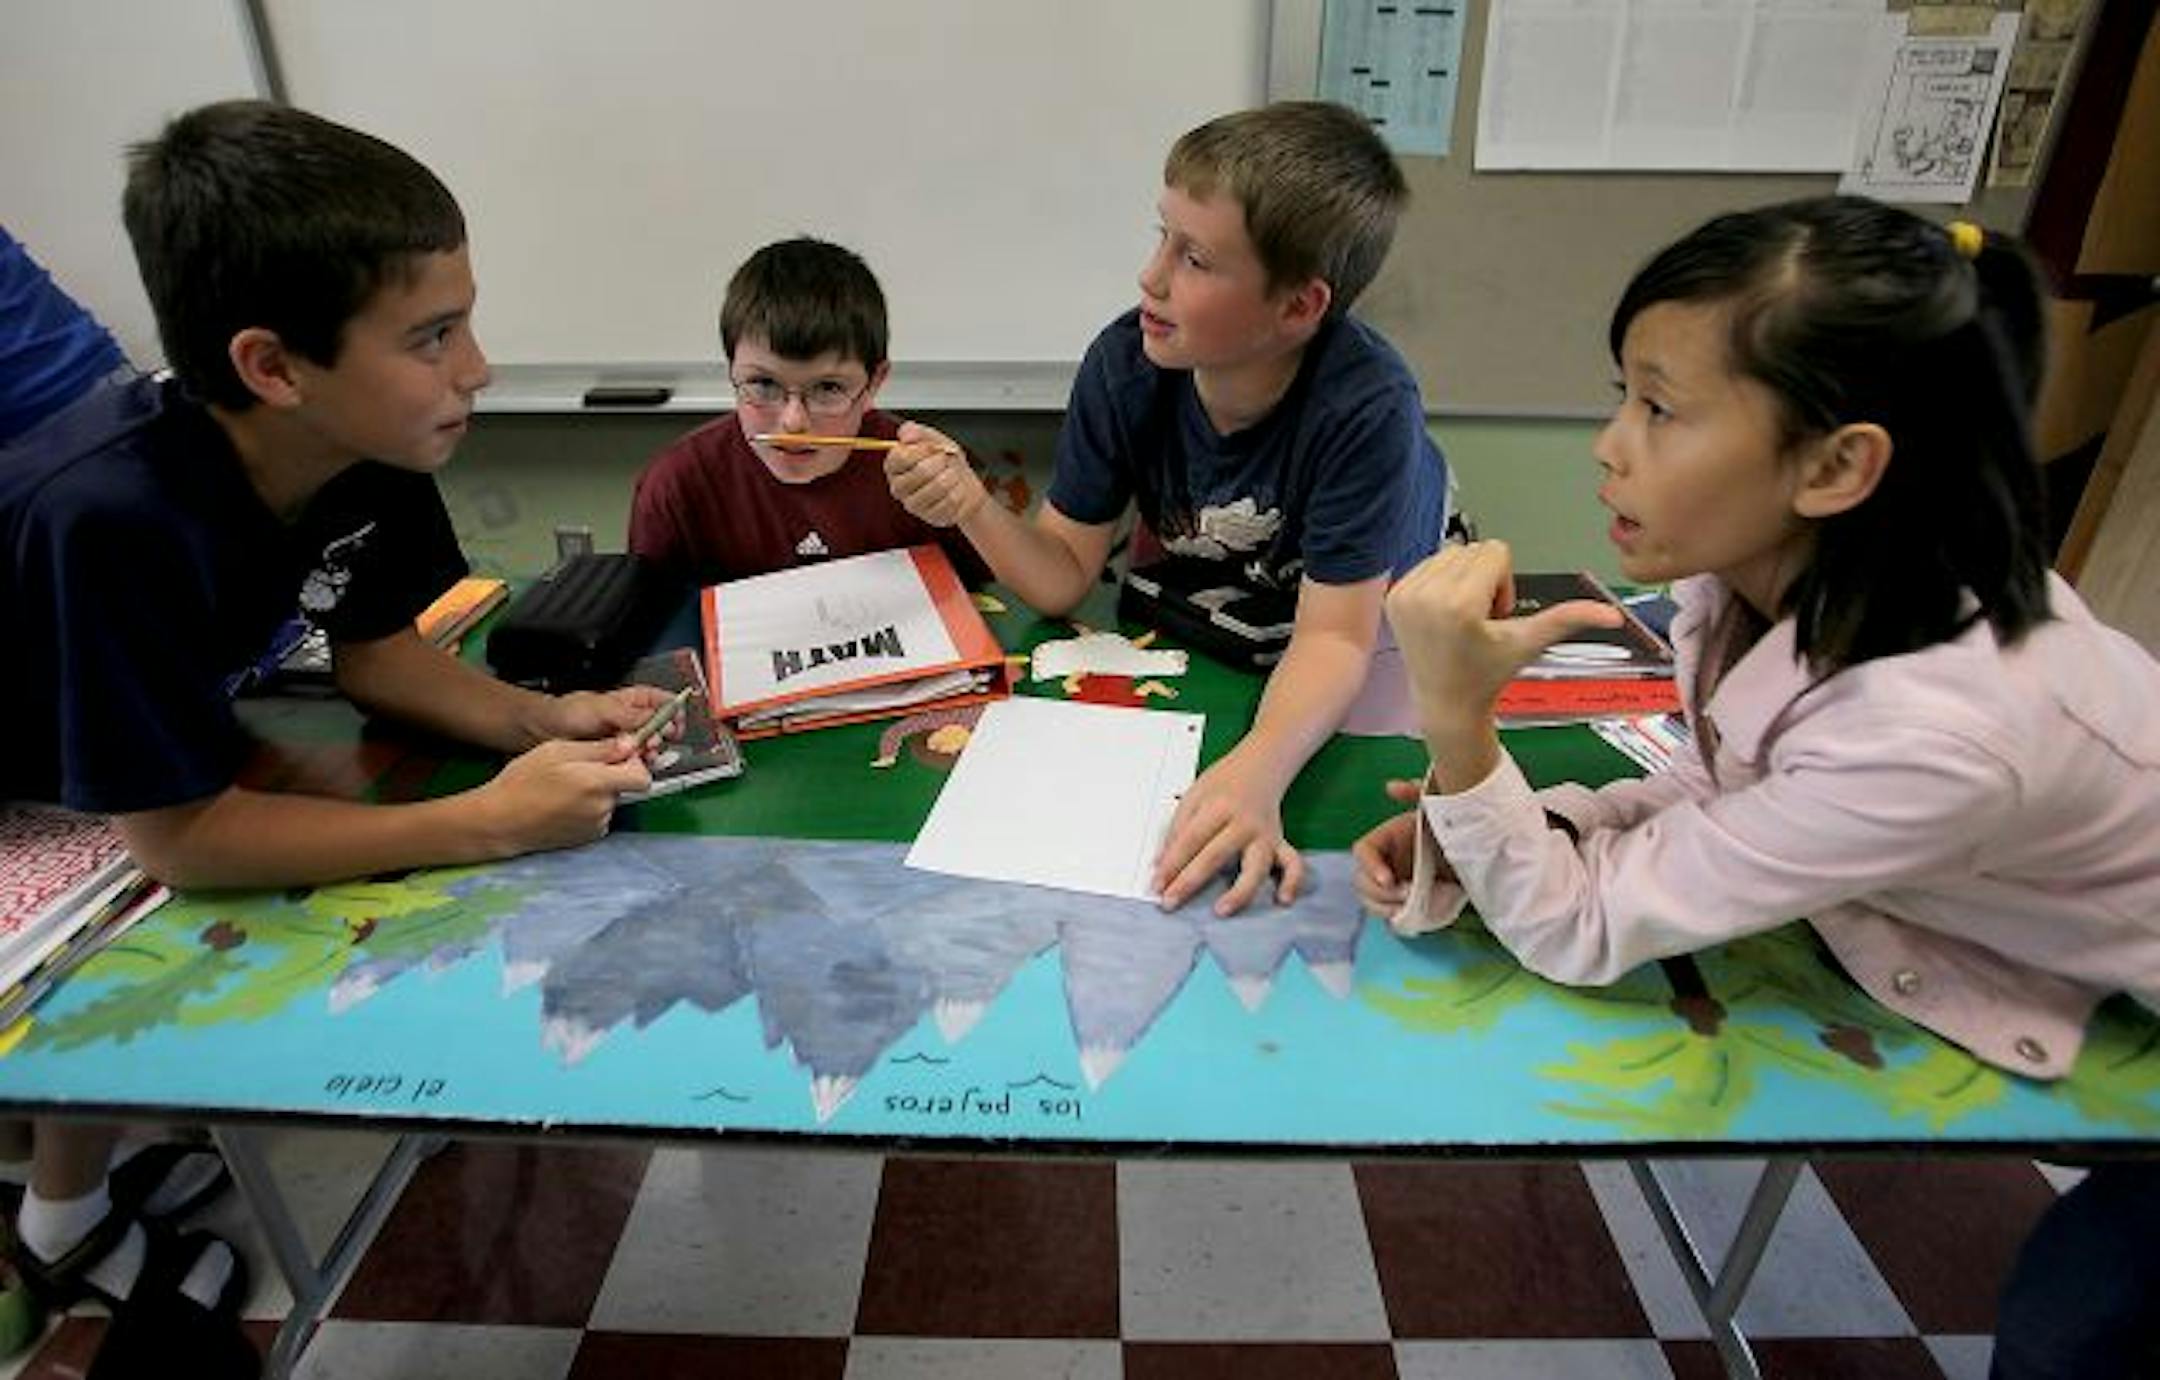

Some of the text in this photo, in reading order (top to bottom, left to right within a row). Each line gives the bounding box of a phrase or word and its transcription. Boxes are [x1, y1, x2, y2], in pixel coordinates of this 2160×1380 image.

[771, 625, 905, 683] MATH
[324, 1075, 446, 1102] el cielo
[885, 1086, 1080, 1119] los pajeros
